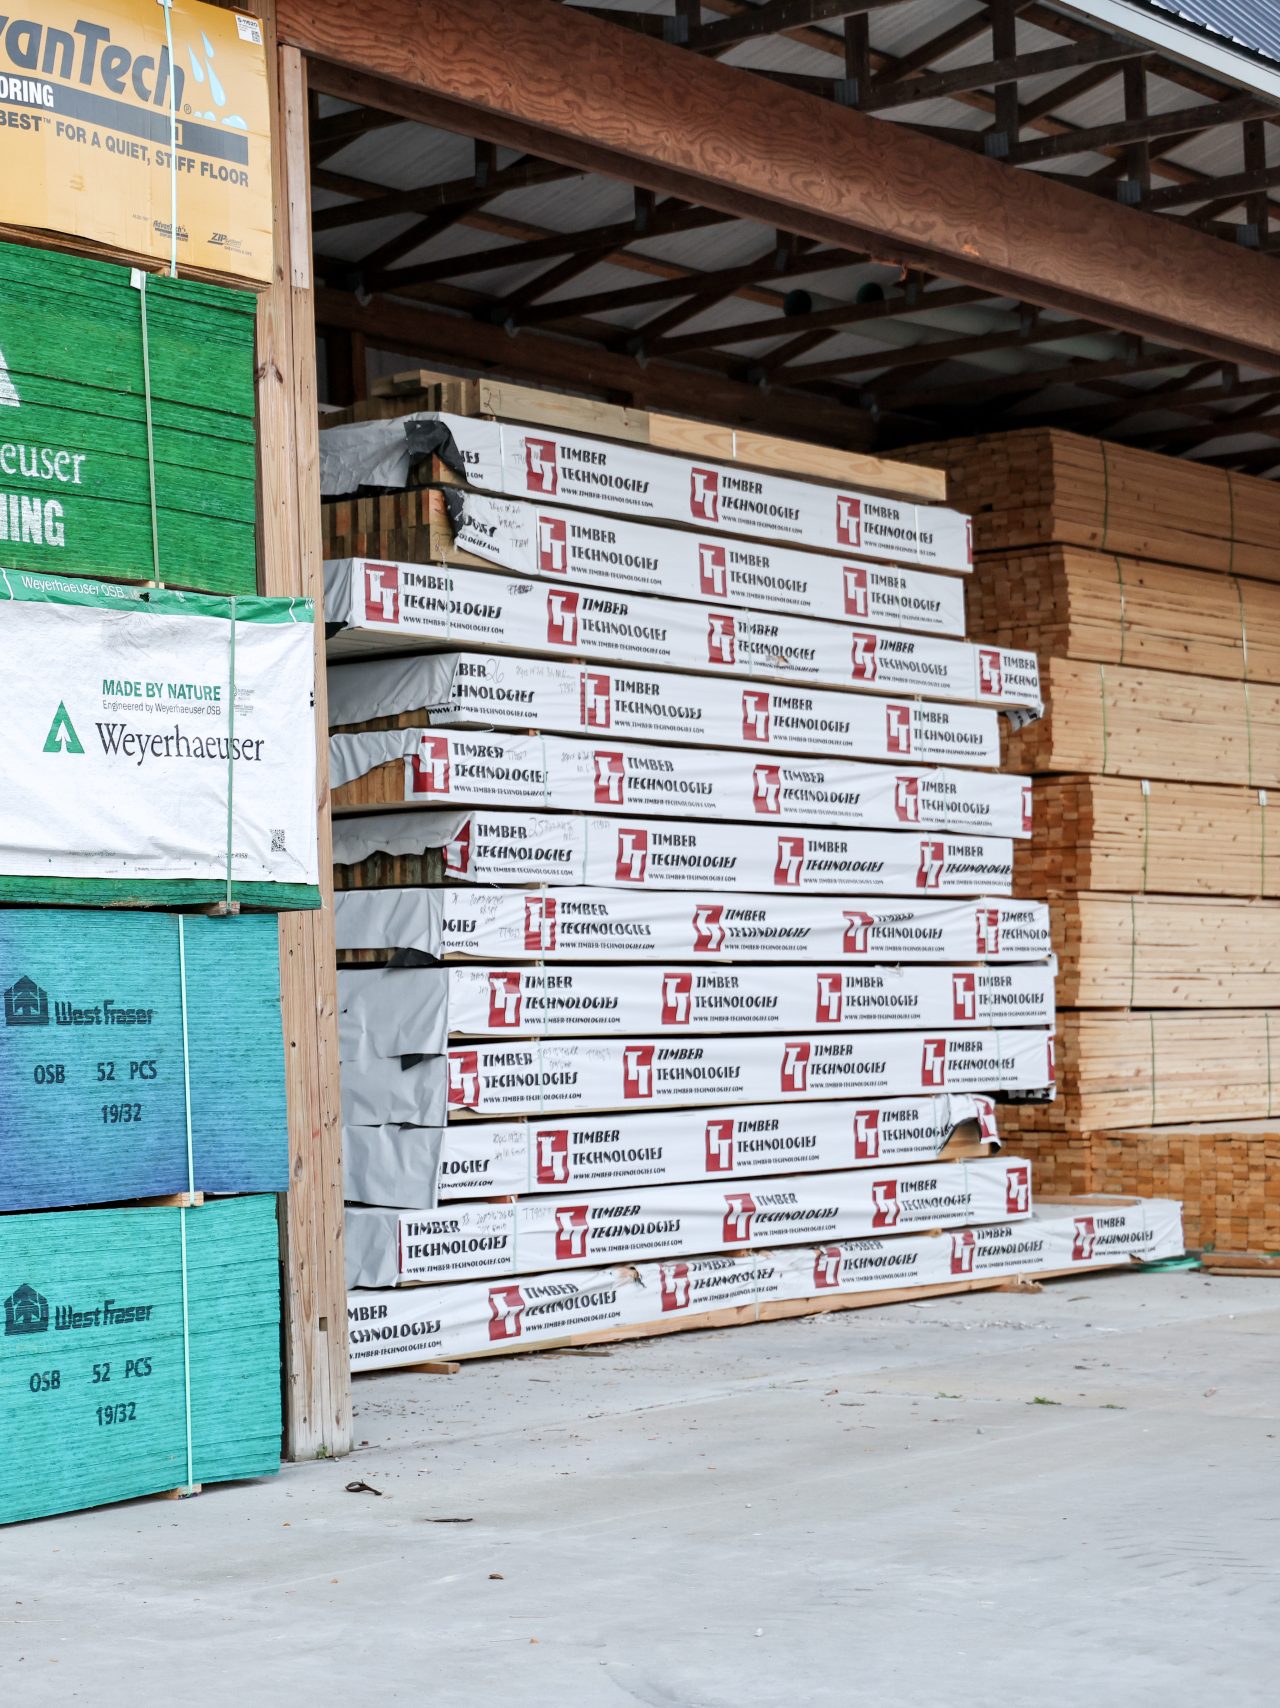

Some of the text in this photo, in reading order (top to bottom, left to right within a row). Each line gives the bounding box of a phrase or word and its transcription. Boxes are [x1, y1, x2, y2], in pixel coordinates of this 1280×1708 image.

[56, 121, 86, 143] FOR
[91, 131, 101, 148] A
[105, 136, 150, 166] QUIET,
[200, 161, 249, 187] FLOOR
[560, 446, 606, 466] TIMBER
[561, 468, 650, 494] TECHNOLOGIES
[722, 476, 762, 495] TIMBER
[571, 525, 616, 544] TIMBER
[571, 546, 659, 571] TECHNOLOGIES
[22, 576, 124, 598] Weyerhaeuser OSB
[403, 594, 502, 619] TECHNOLOGIES
[582, 598, 628, 616] TIMBER
[581, 618, 667, 641] TECHNOLOGIES
[880, 639, 915, 654] TIMBER
[879, 657, 948, 677] TECHNOLOGIES
[102, 679, 221, 701] MADE BY NATURE
[615, 679, 660, 696] TIMBER
[102, 700, 220, 715] Engineered by Weyerhaeuser OSB
[615, 700, 702, 720] TECHNOLOGIES
[772, 696, 812, 711] TIMBER
[774, 715, 850, 733] TECHNOLOGIES
[95, 722, 264, 766] Weyerhaeuser
[452, 743, 503, 759] TIMBER
[628, 757, 674, 773] TIMBER
[783, 769, 824, 783] TIMBER
[628, 776, 713, 794] TECHNOLOGIES
[783, 788, 860, 805] TECHNOLOGIES
[477, 824, 527, 839] TIMBER
[651, 833, 696, 848] TIMBER
[477, 846, 572, 862] TECHNOLOGIES
[947, 845, 983, 857] TIMBER
[651, 853, 737, 869] TECHNOLOGIES
[561, 902, 608, 916] TIMBER
[725, 909, 766, 922] TIMBER
[560, 922, 651, 936] TECHNOLOGIES
[525, 976, 572, 989] TIMBER
[696, 976, 739, 988] TIMBER
[846, 976, 883, 988] TIMBER
[525, 996, 618, 1010] TECHNOLOGIES
[846, 995, 918, 1007] TECHNOLOGIES
[657, 1048, 703, 1060] TIMBER
[814, 1044, 853, 1056] TIMBER
[948, 1041, 983, 1053] TIMBER
[482, 1052, 532, 1067] TIMBER
[34, 1060, 157, 1084] OSB 52 PCS
[656, 1066, 740, 1081] TECHNOLOGIES
[483, 1072, 577, 1089] TECHNOLOGIES
[101, 1103, 142, 1123] 19/32
[737, 1119, 779, 1132] TIMBER
[572, 1129, 620, 1145] TIMBER
[737, 1135, 816, 1152] TECHNOLOGIES
[572, 1147, 662, 1165] TECHNOLOGIES
[900, 1179, 937, 1193] TIMBER
[591, 1205, 640, 1220] TIMBER
[406, 1219, 460, 1237] TIMBER
[591, 1219, 681, 1239] TECHNOLOGIES
[407, 1235, 508, 1259] TECHNOLOGIES
[977, 1240, 1043, 1257] TECHNOLOGIES
[524, 1283, 579, 1299] TIMBER
[29, 1357, 152, 1392] OSB 52 PCS
[96, 1402, 136, 1425] 19/32
